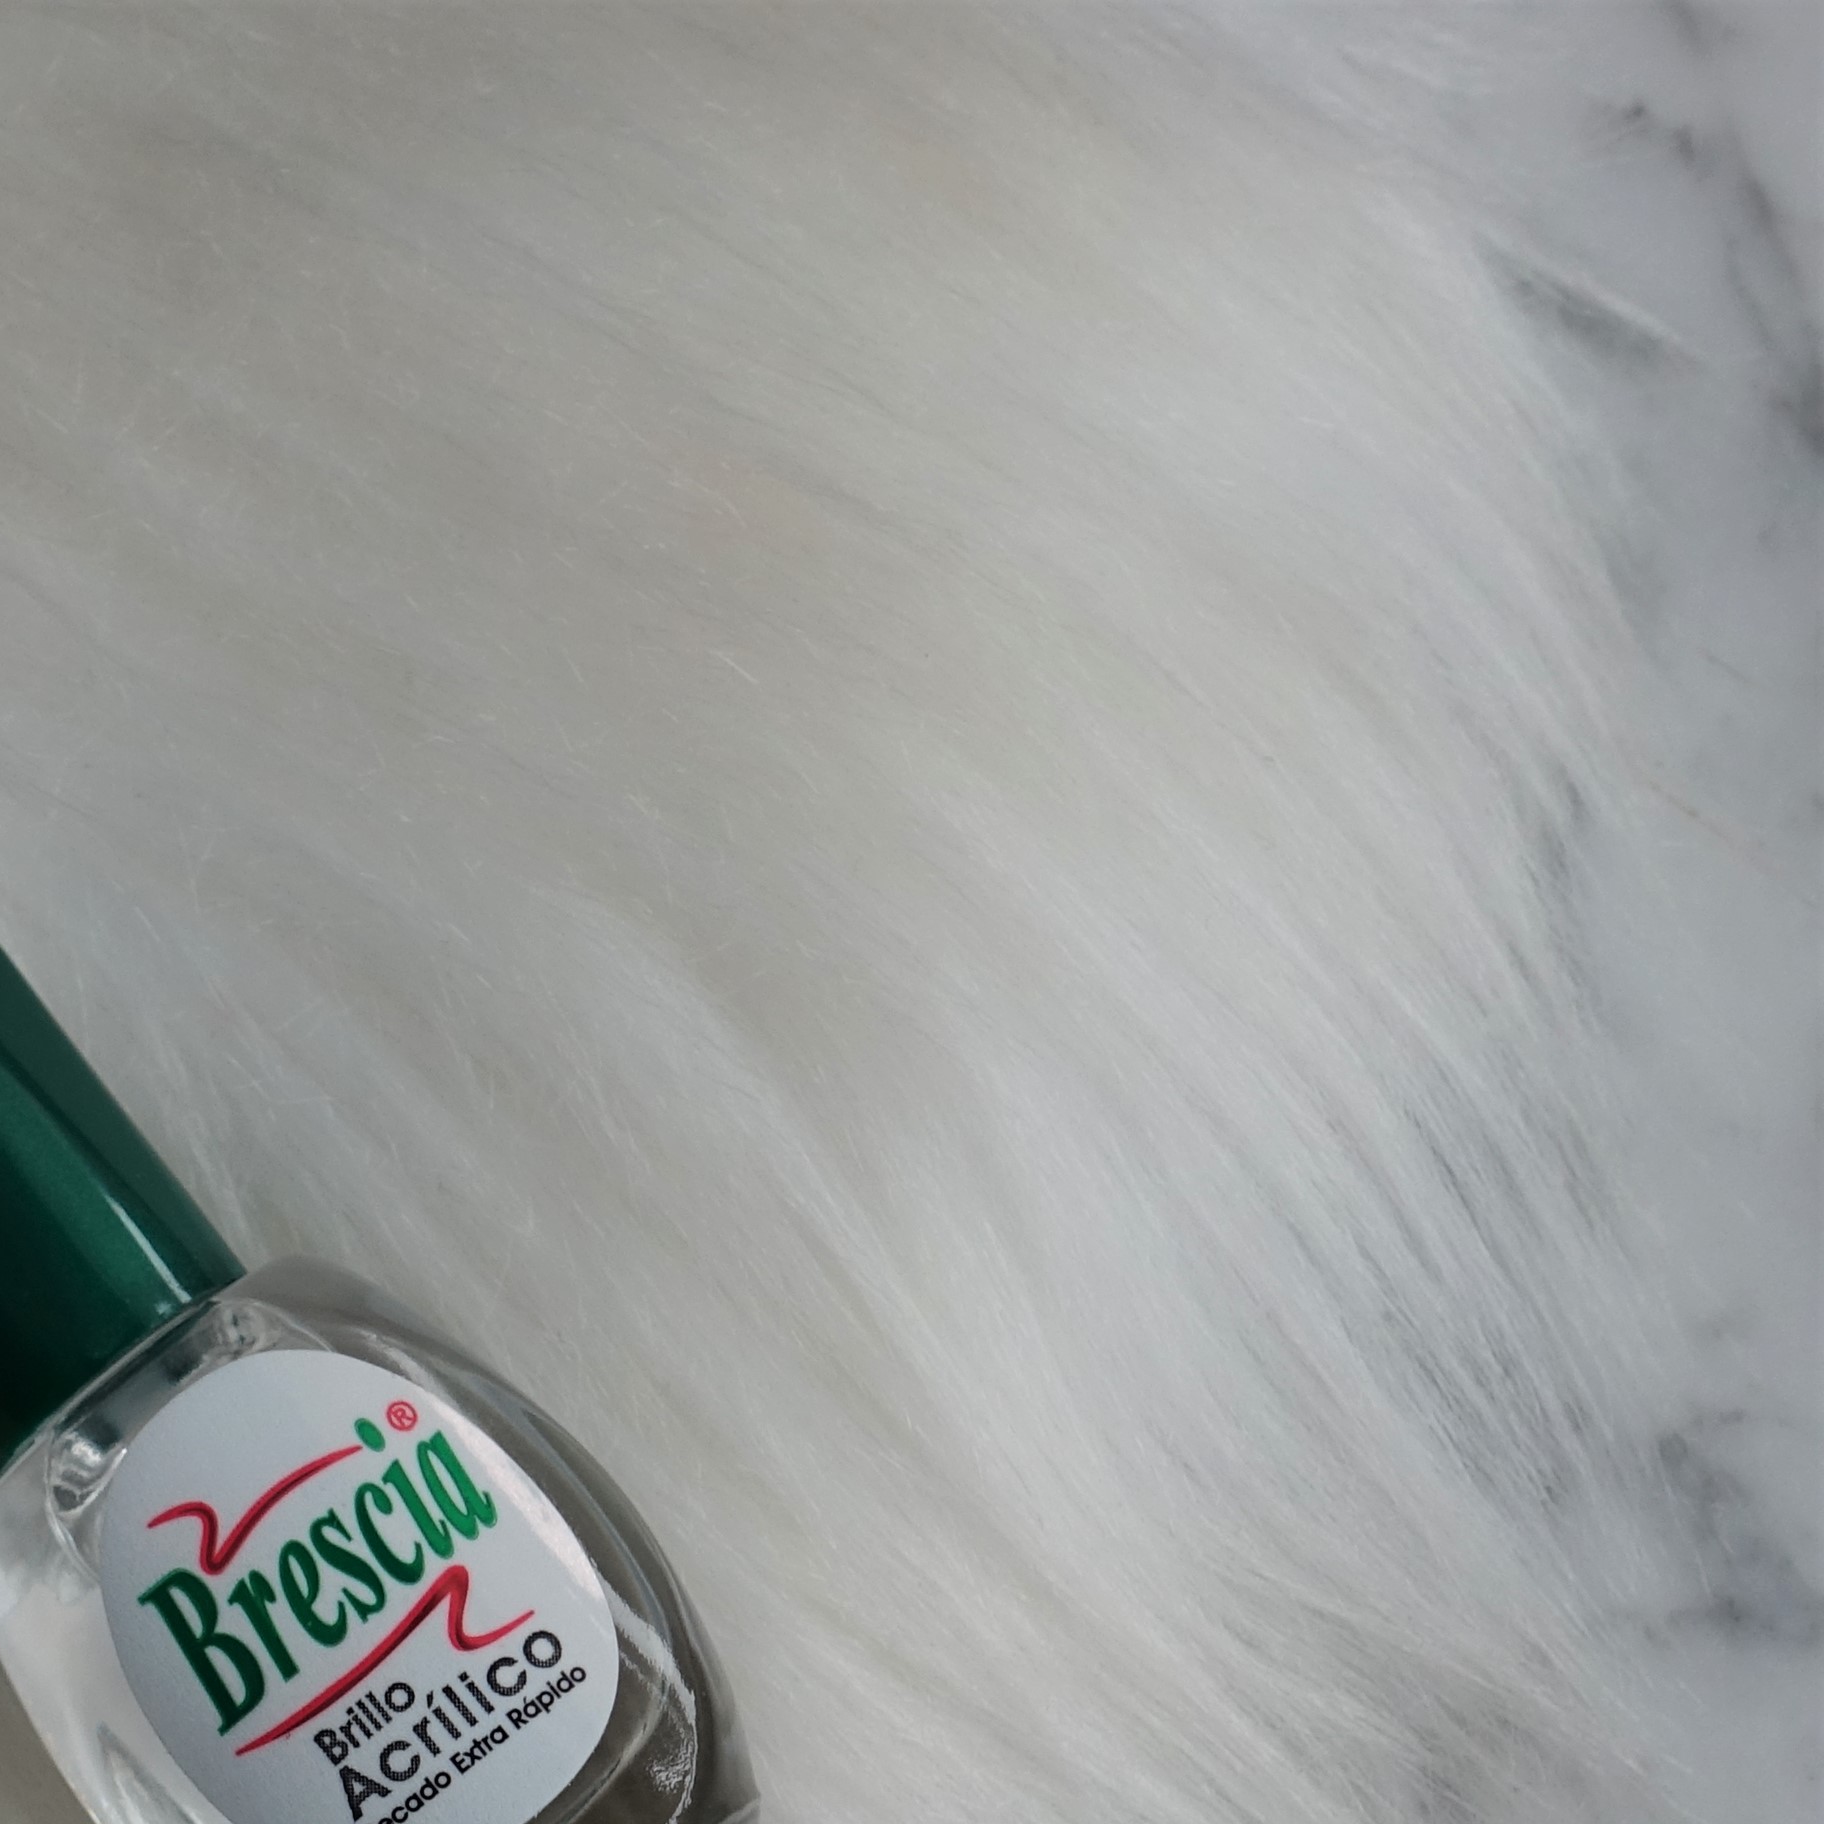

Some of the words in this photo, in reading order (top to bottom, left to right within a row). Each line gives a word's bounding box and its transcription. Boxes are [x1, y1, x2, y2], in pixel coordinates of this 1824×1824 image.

[313, 1682, 416, 1767] Brillo
[339, 1629, 563, 1823] Acrílico
[449, 1724, 510, 1775] Extra
[505, 1666, 587, 1730] Rápido
